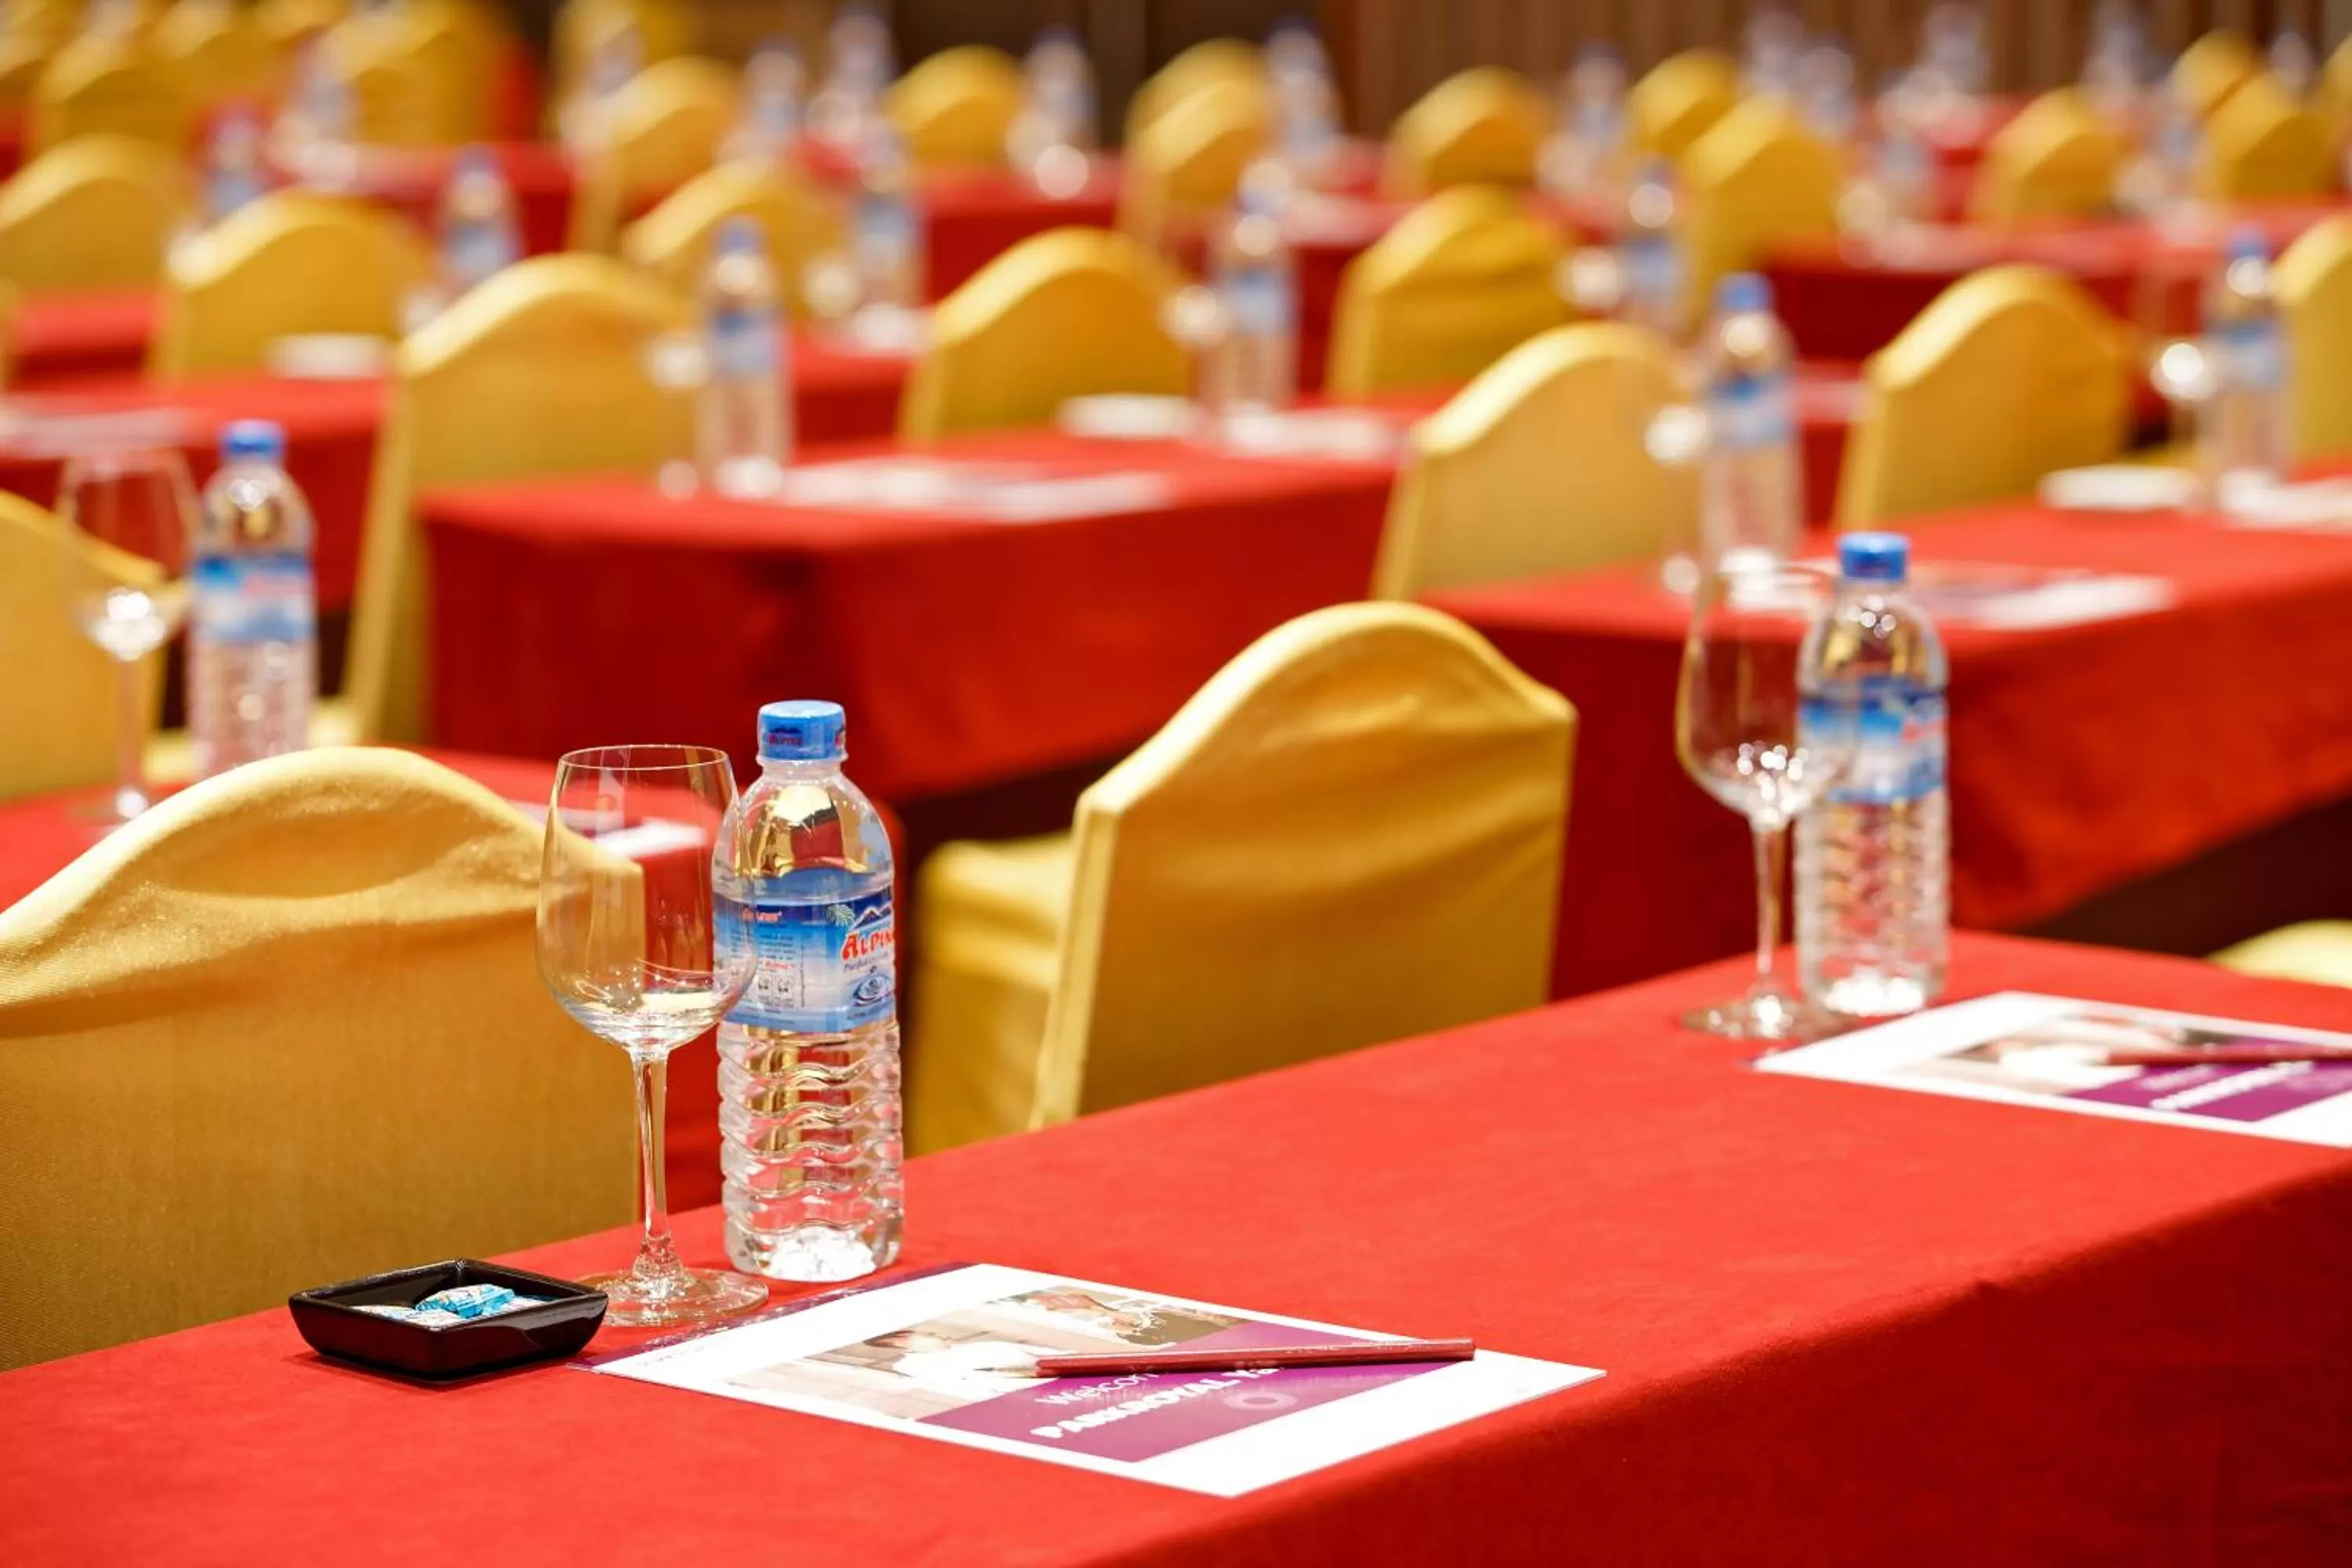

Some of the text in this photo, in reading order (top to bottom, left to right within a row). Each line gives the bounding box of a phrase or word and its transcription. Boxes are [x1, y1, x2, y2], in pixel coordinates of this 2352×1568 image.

[841, 928, 894, 961] ALPIN
[1033, 1372, 1160, 1406] Welcom
[1029, 1377, 1241, 1439] PARKROYAL
